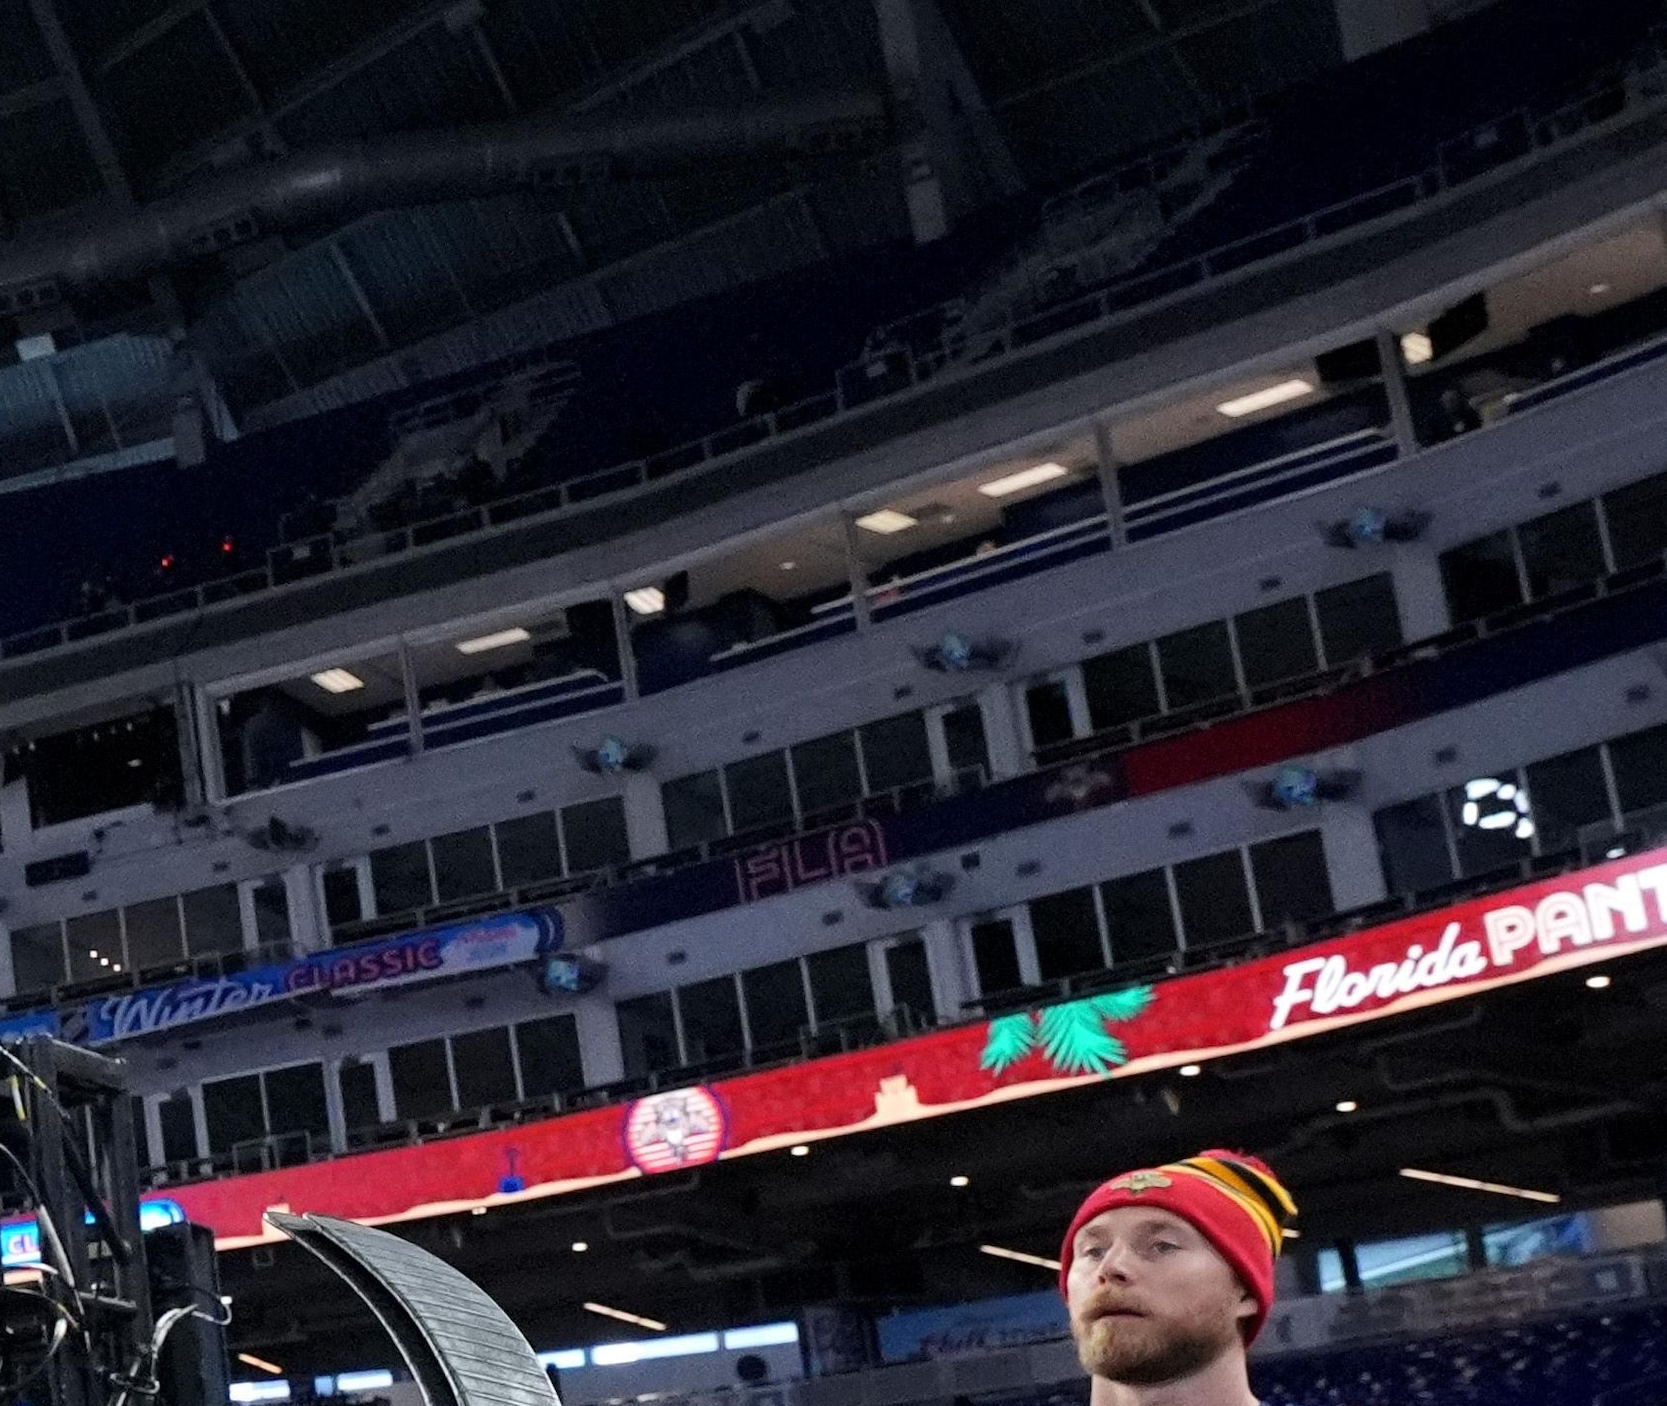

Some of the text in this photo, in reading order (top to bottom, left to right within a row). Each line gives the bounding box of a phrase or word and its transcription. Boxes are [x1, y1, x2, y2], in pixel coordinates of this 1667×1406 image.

[734, 816, 889, 903] FLA
[101, 980, 272, 1038] Winter
[282, 938, 443, 995] CLASSIC
[1269, 922, 1487, 1031] Florida
